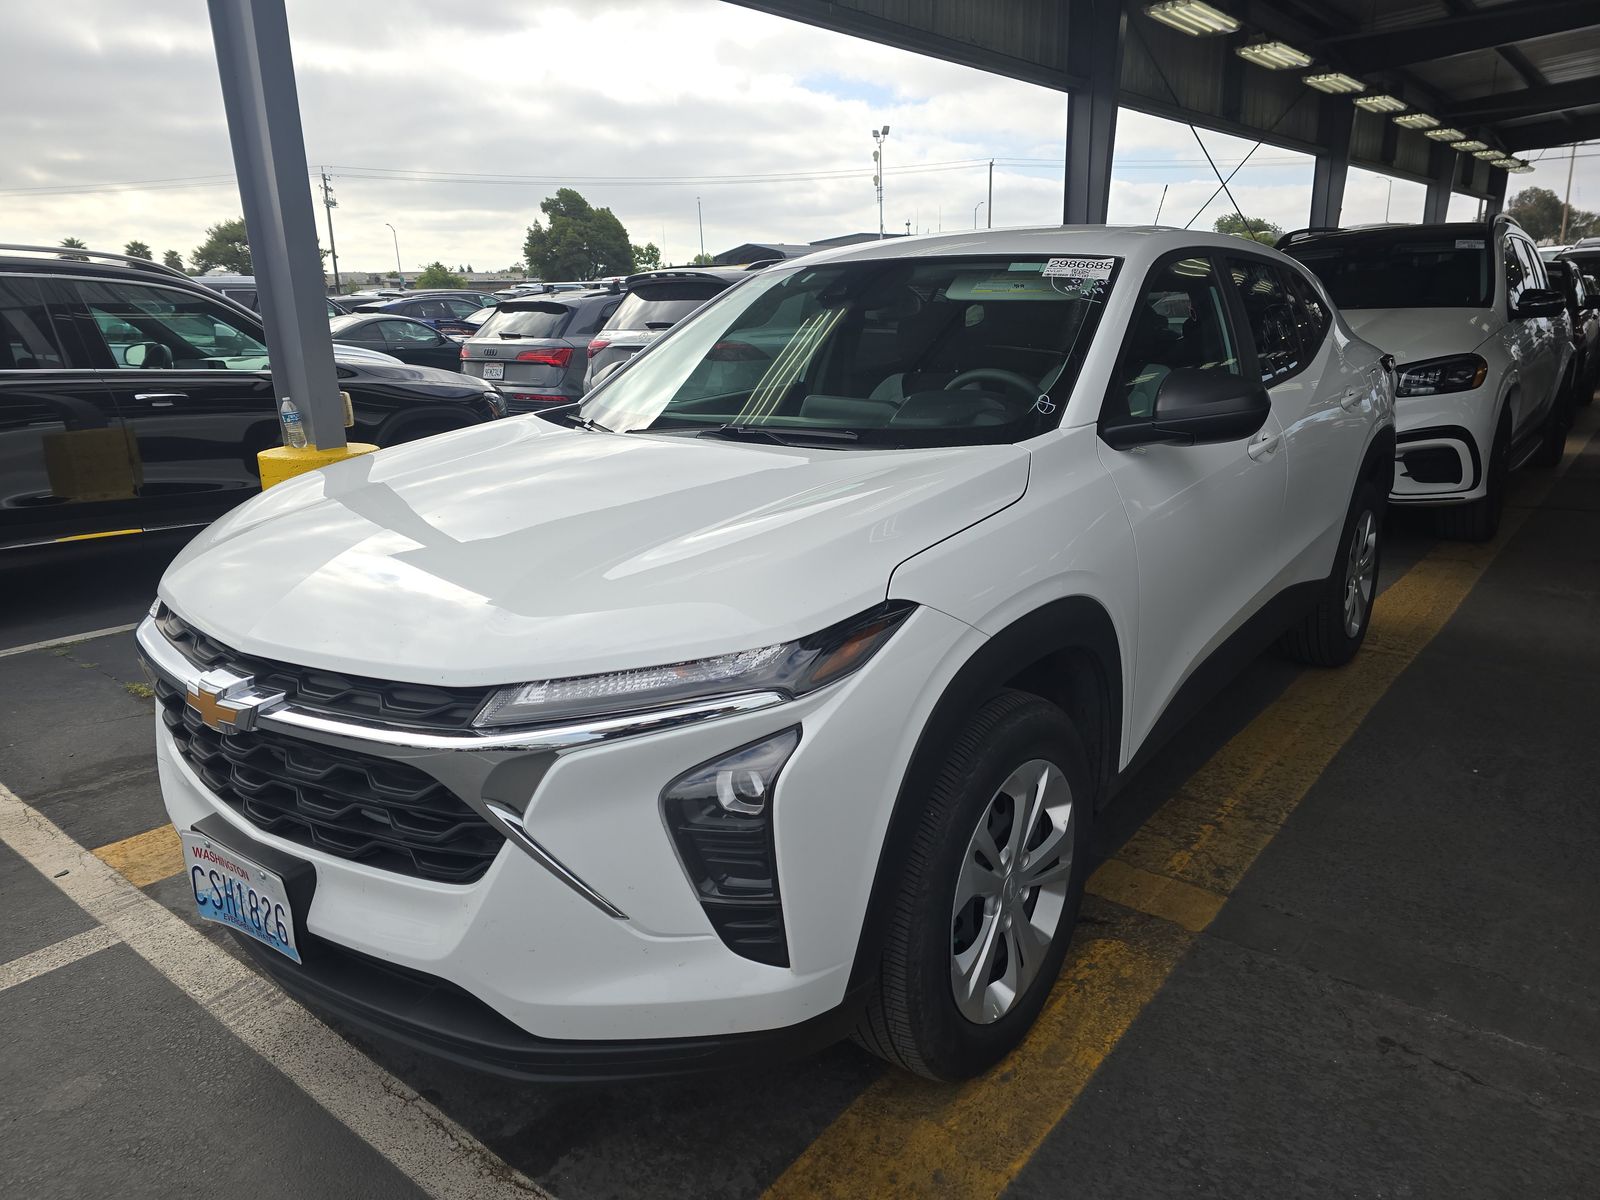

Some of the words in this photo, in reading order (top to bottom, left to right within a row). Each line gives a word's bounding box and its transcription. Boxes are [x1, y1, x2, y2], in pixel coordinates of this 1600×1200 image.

[1049, 260, 1113, 270] 2986685
[192, 846, 250, 881] WASHINGTON
[191, 865, 289, 946] CSH1826
